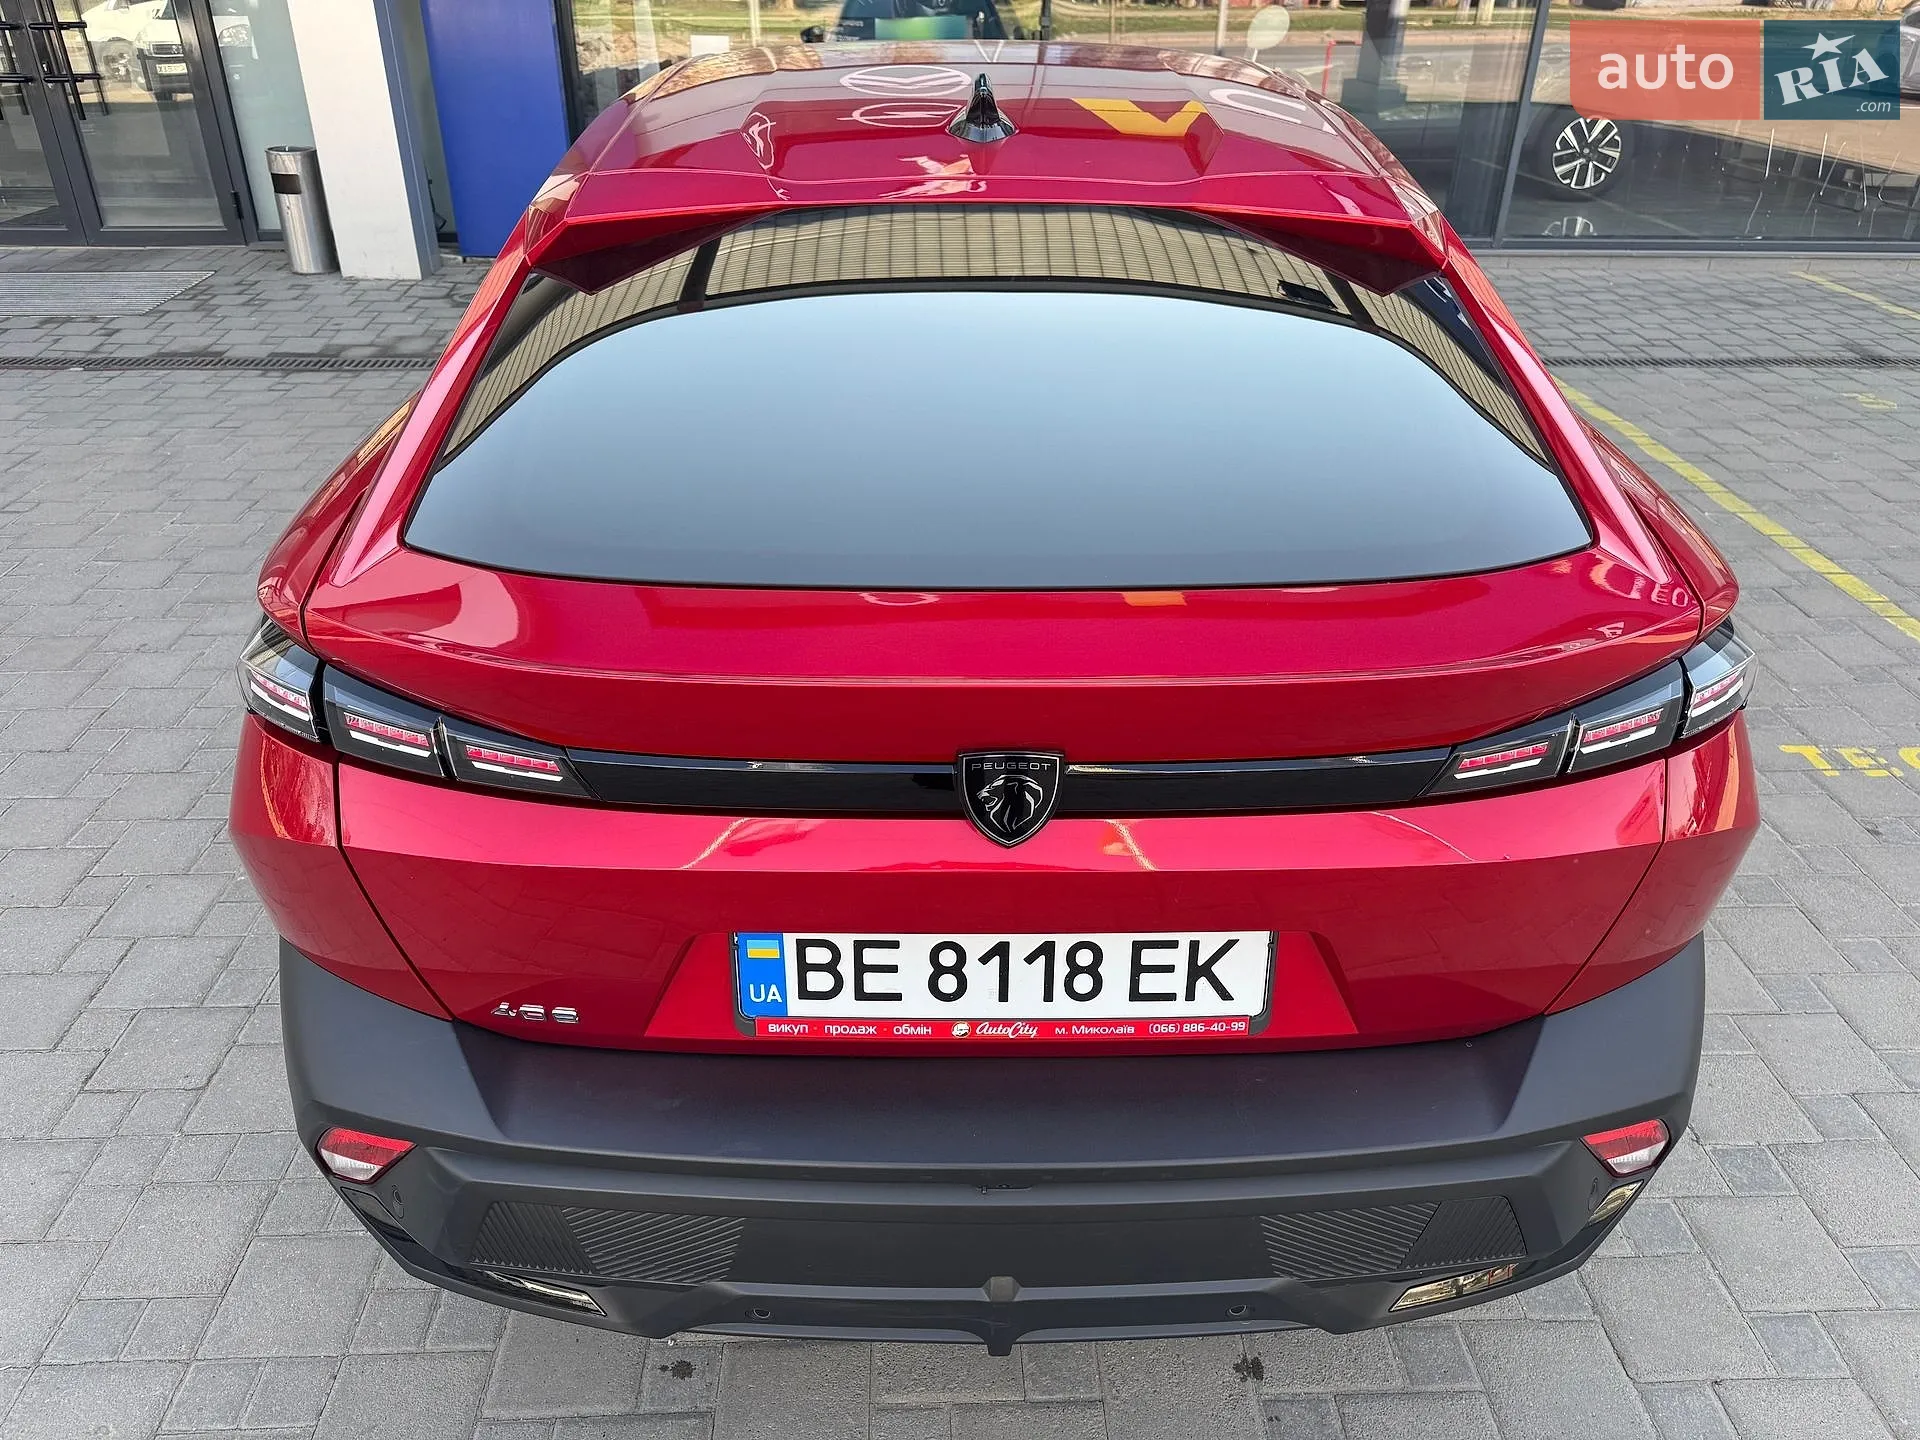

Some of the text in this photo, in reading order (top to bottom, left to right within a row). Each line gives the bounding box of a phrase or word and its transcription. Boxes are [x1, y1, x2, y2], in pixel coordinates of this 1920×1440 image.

[972, 762, 1051, 770] PEUGEOT
[796, 938, 1240, 1002] BE 8118 EK
[750, 984, 782, 1003] UA
[768, 1021, 1246, 1039] викуп продаж обмін AutoCity м. Миколаїв (066) 886-40-99
